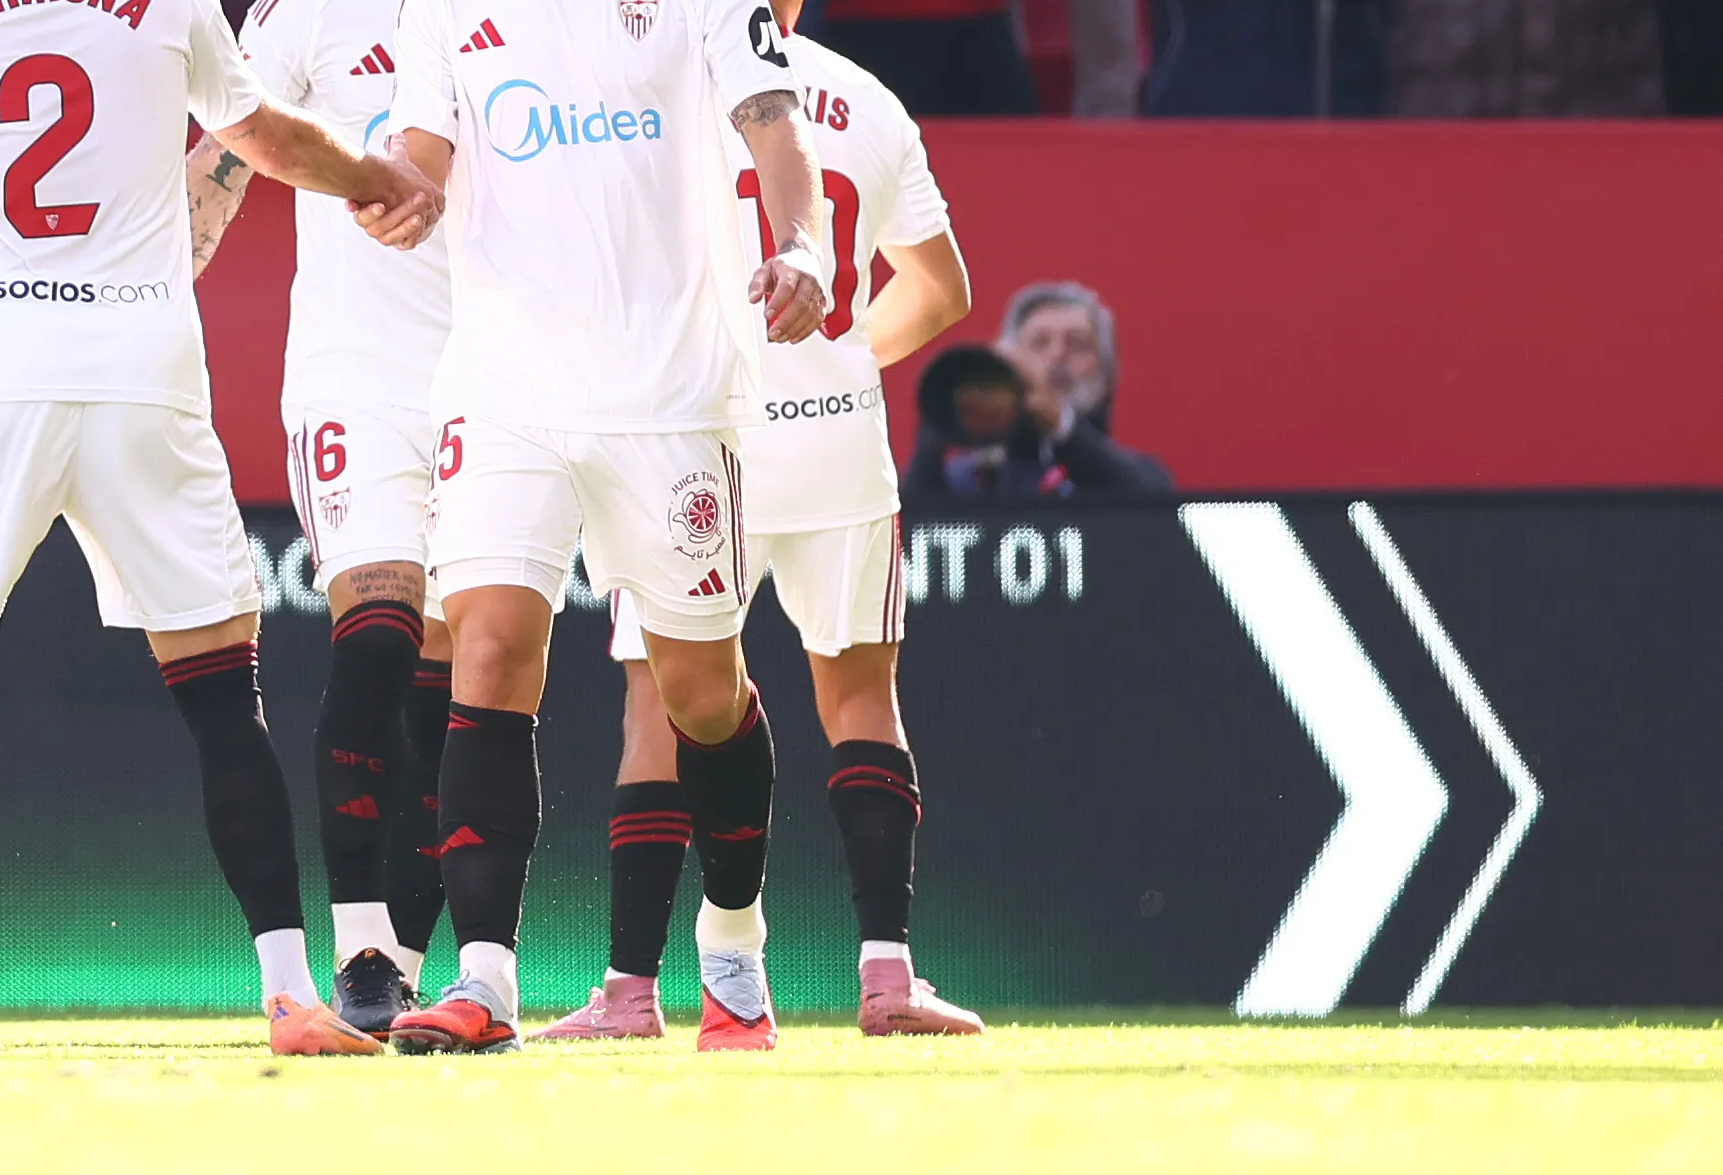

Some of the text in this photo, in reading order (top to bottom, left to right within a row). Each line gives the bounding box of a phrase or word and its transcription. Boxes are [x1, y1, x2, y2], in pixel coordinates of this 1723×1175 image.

[484, 79, 661, 162] Midea
[314, 421, 346, 482] 6
[671, 471, 720, 496] JUICE TIME
[994, 524, 1084, 608] 01
[332, 748, 385, 773] SFC
